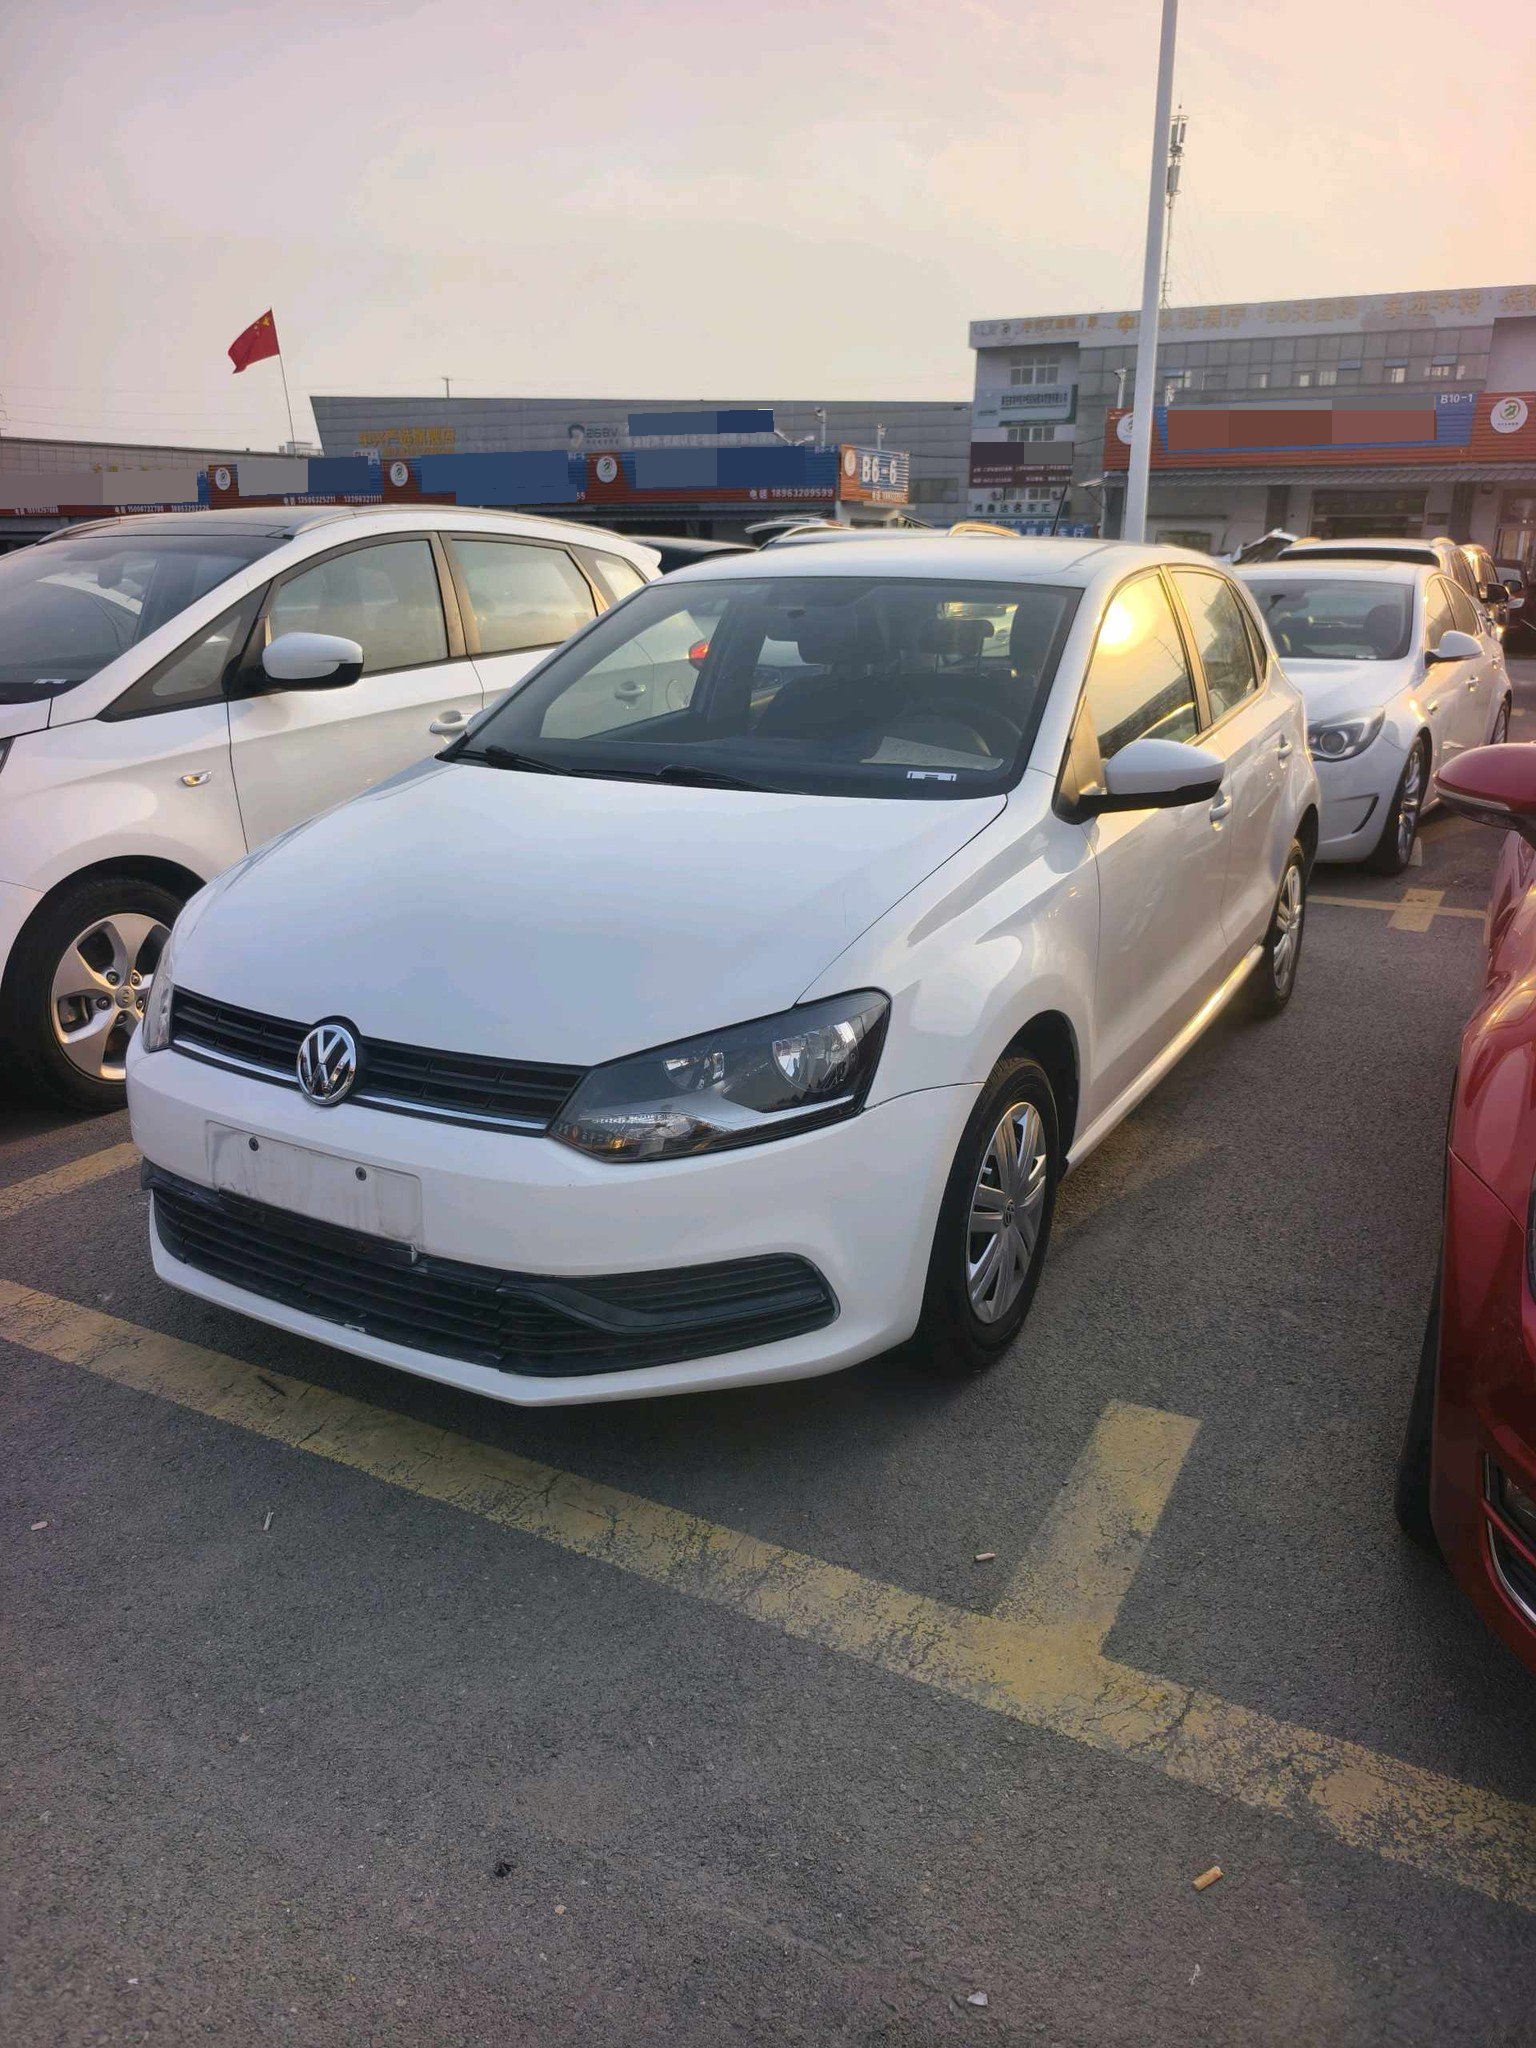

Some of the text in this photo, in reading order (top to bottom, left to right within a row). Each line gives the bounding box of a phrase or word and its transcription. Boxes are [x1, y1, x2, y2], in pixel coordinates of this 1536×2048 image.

[1440, 393, 1473, 404] B10-1
[862, 456, 897, 484] B6-6
[749, 488, 768, 500] 电话
